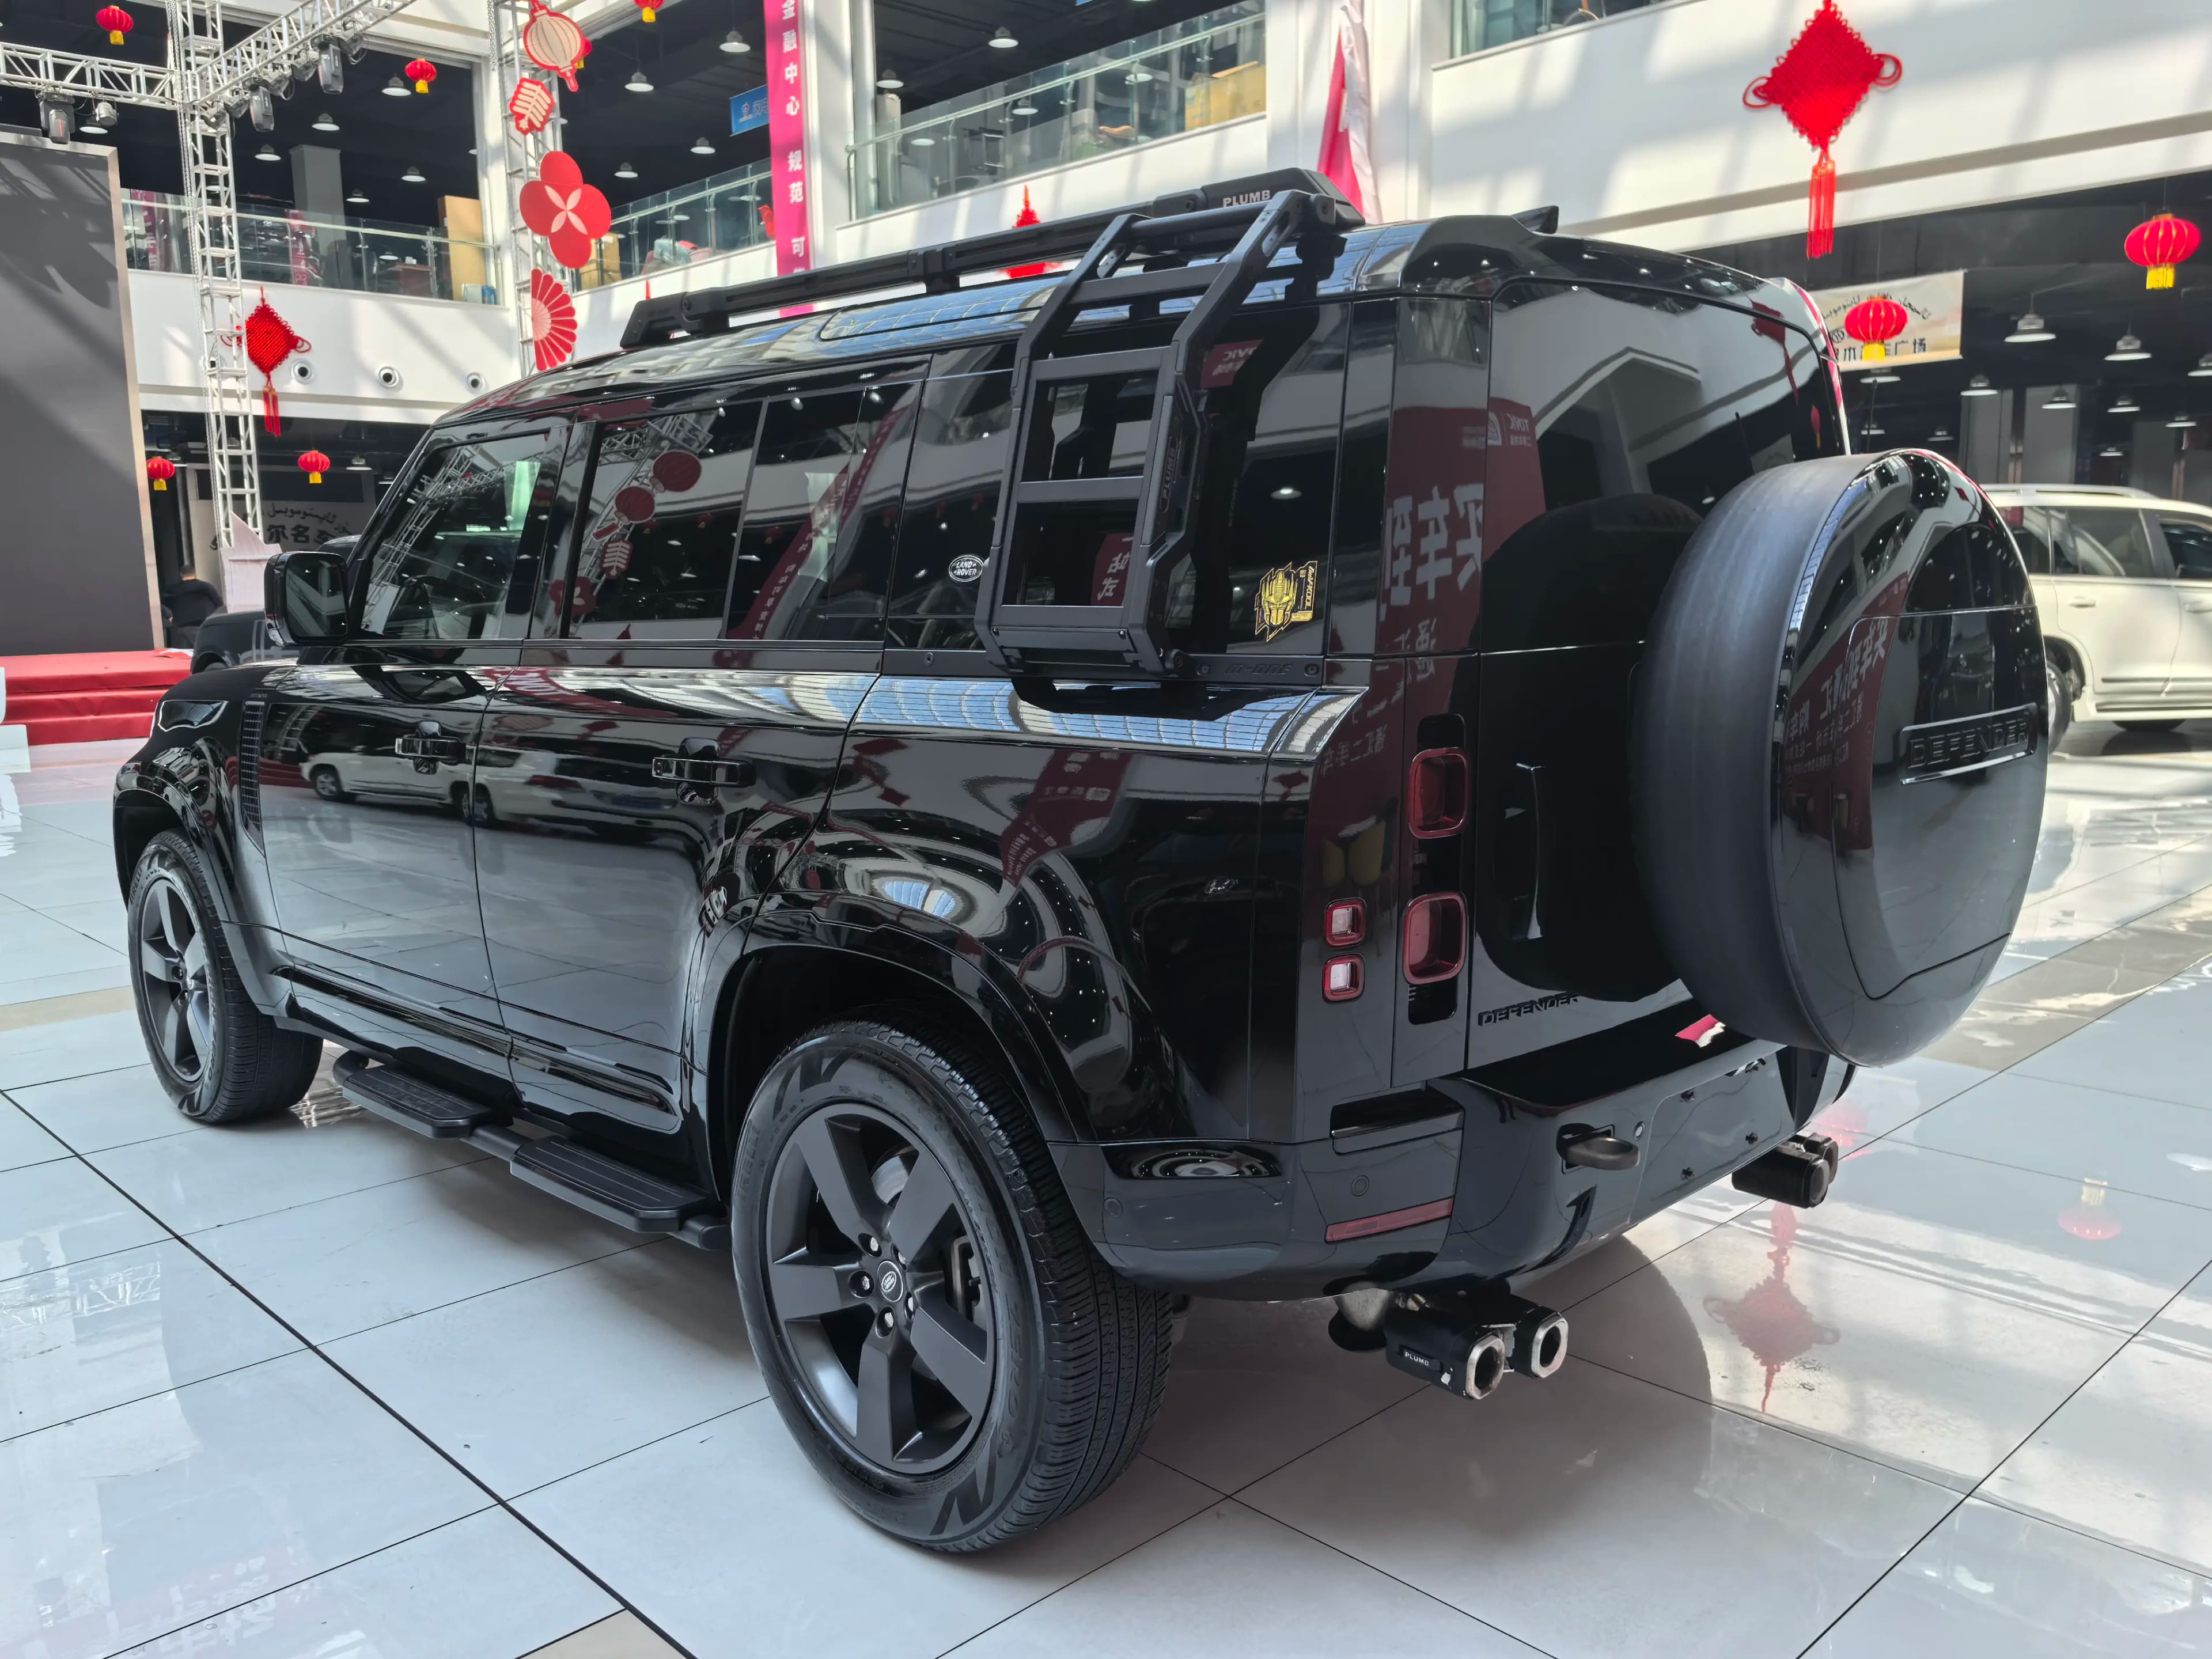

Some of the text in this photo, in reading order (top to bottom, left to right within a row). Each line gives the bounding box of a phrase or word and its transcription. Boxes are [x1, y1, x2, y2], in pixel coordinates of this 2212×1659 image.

[787, 150, 804, 203] 规范
[1222, 190, 1271, 208] PLUMB
[956, 560, 972, 569] LAND
[957, 568, 977, 576] ROVER
[1908, 718, 2029, 768] DEFENDER
[1478, 990, 1580, 1027] DEFENDER
[1405, 1351, 1429, 1366] PLUMB
